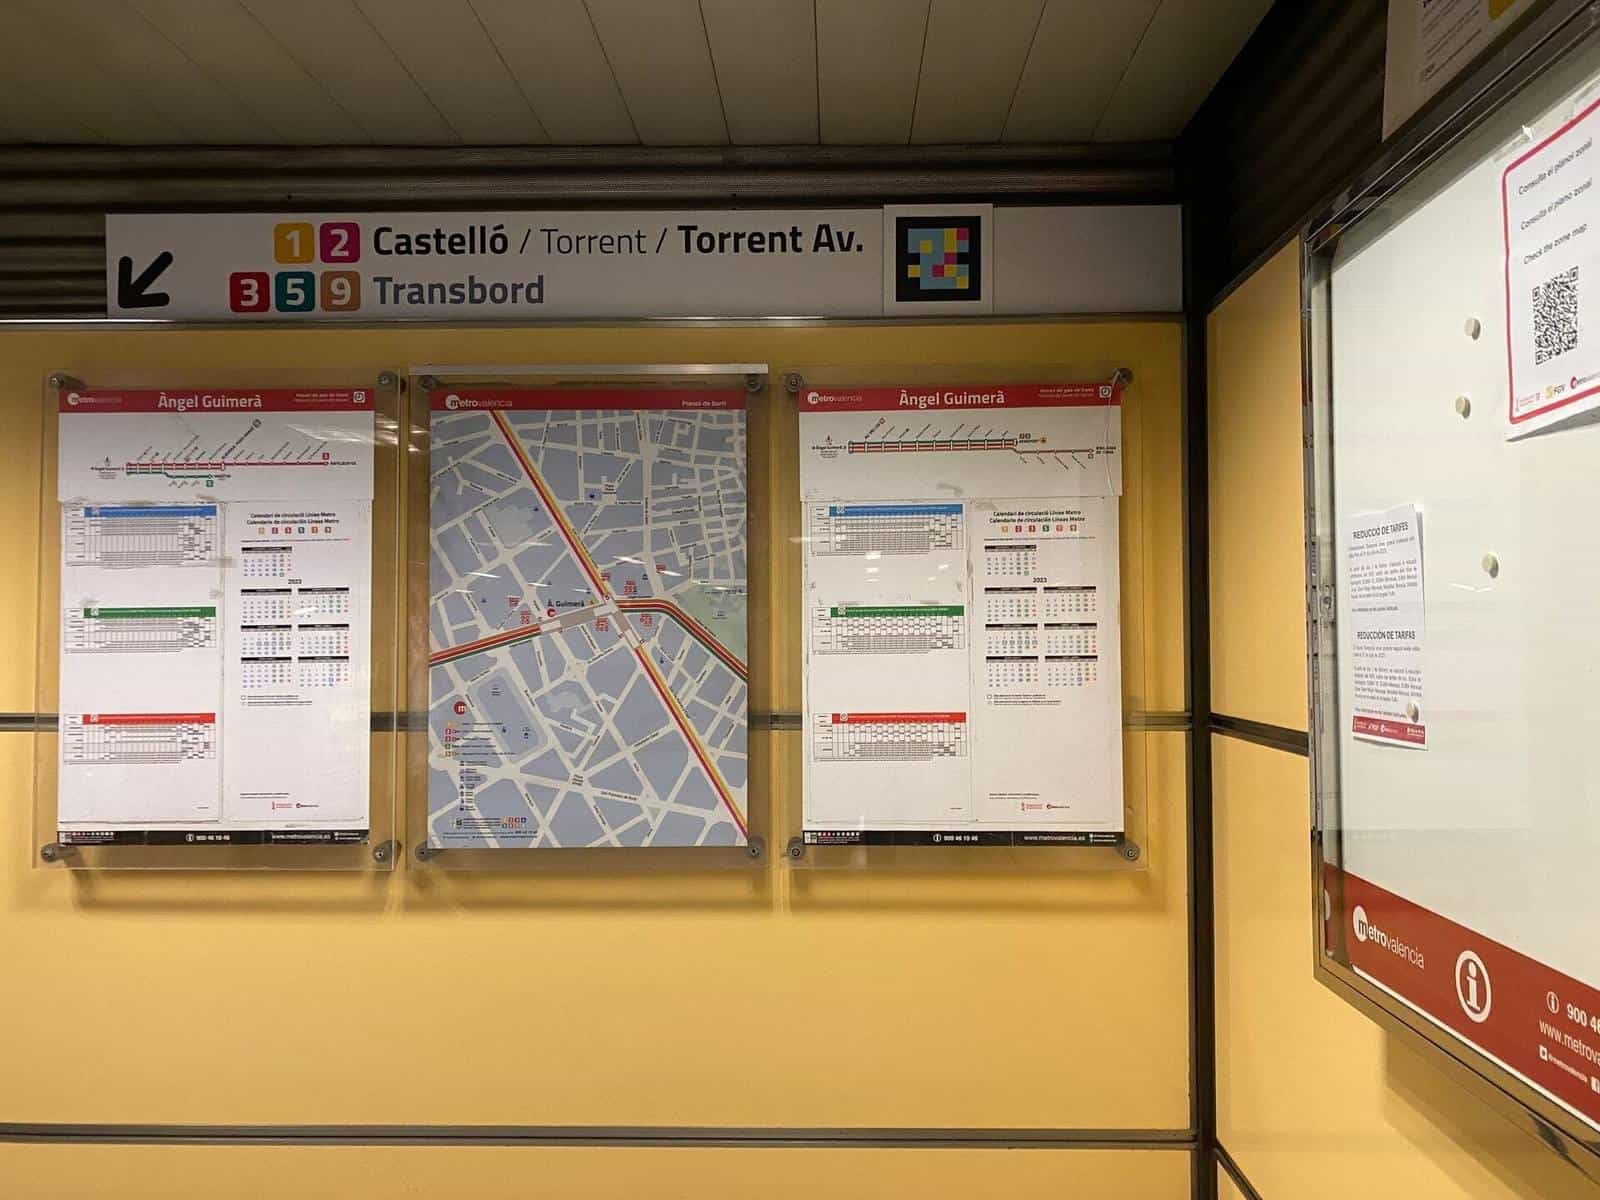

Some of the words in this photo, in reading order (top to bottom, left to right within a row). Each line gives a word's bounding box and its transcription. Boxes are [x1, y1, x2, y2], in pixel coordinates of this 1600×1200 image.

[329, 229, 350, 258] 2
[373, 224, 509, 256] Castelló
[519, 228, 532, 255] /
[540, 227, 647, 255] Torrent
[655, 228, 668, 254] /
[677, 224, 802, 254] Torrent
[812, 223, 864, 253] Av.
[239, 279, 259, 307] 3
[285, 277, 306, 306] 5
[330, 277, 351, 306] 9
[373, 275, 544, 305] Transbord
[157, 392, 198, 410] Àngel
[202, 392, 263, 409] Guimerà
[899, 389, 941, 409] Àngel
[943, 389, 1006, 407] Guimerà
[1354, 908, 1425, 971] metrovalencia
[1566, 1003, 1588, 1027] 900
